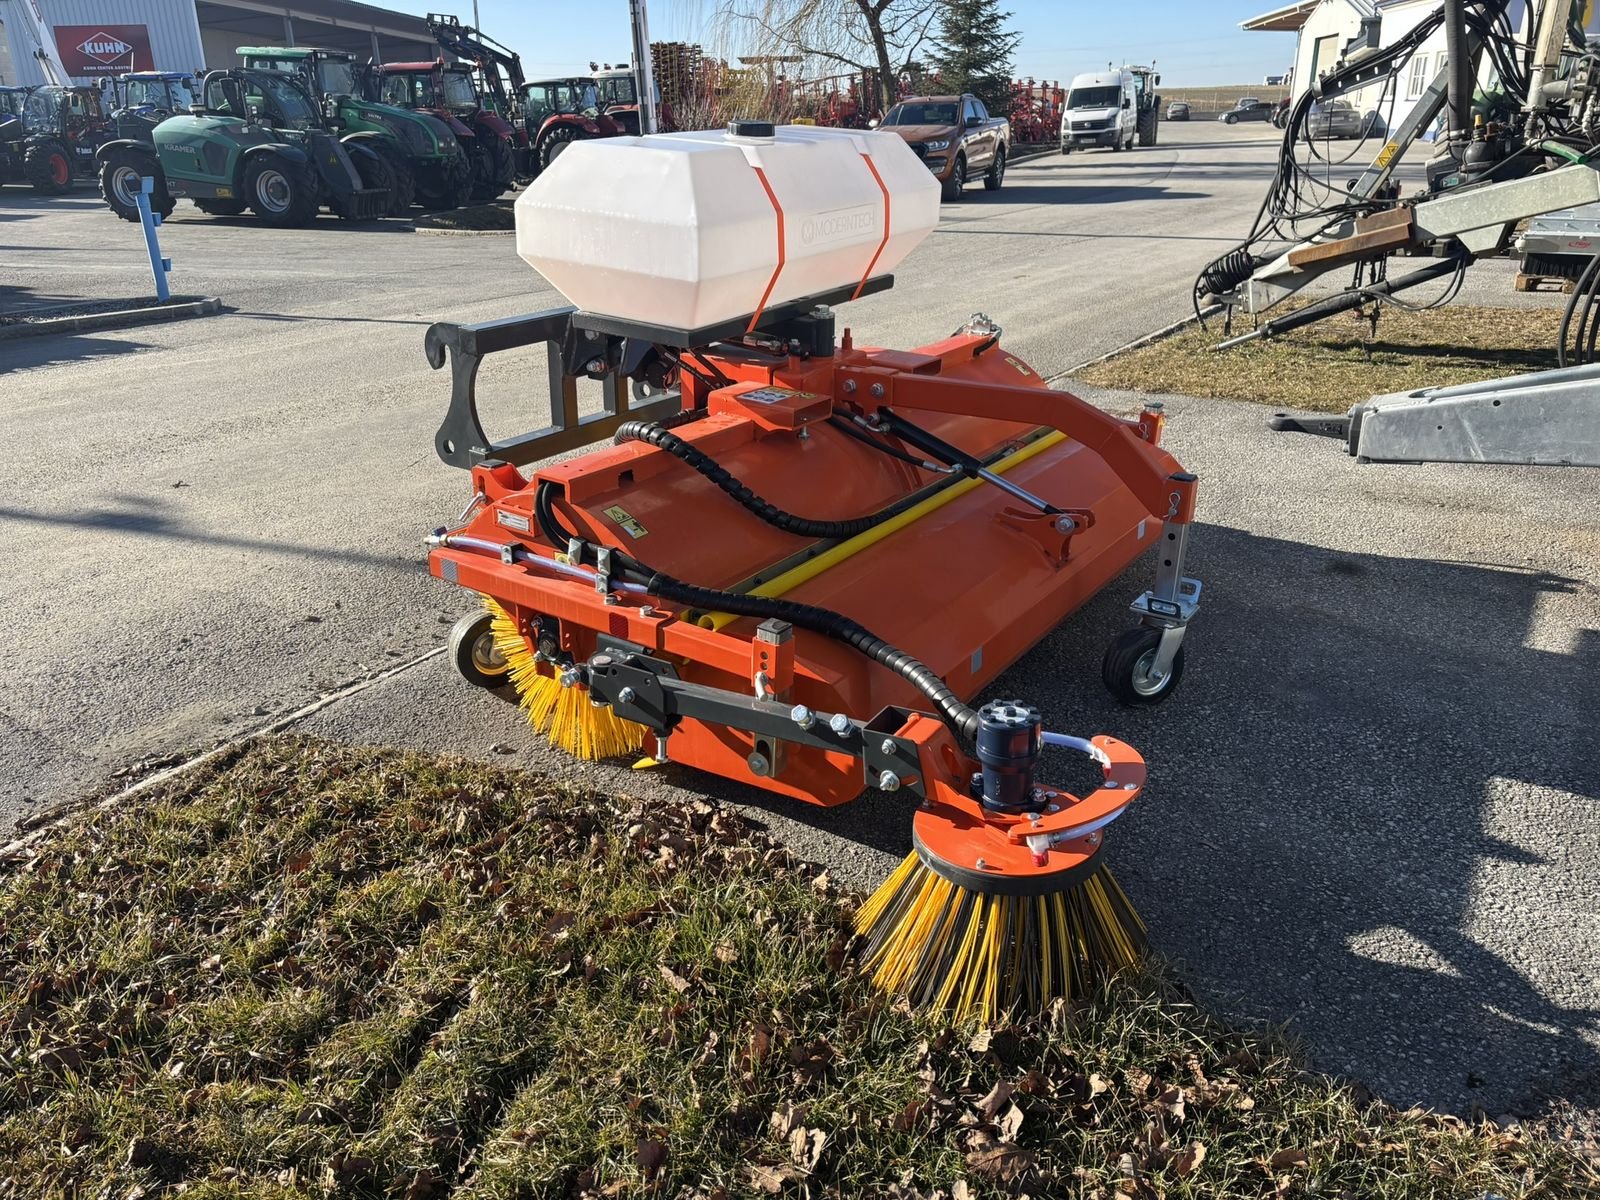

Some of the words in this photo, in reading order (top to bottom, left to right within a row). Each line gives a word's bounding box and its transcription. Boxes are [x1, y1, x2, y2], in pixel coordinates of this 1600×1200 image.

[84, 42, 125, 54] KUHN
[164, 143, 196, 154] KRAMER
[815, 212, 875, 238] MODERNTECH
